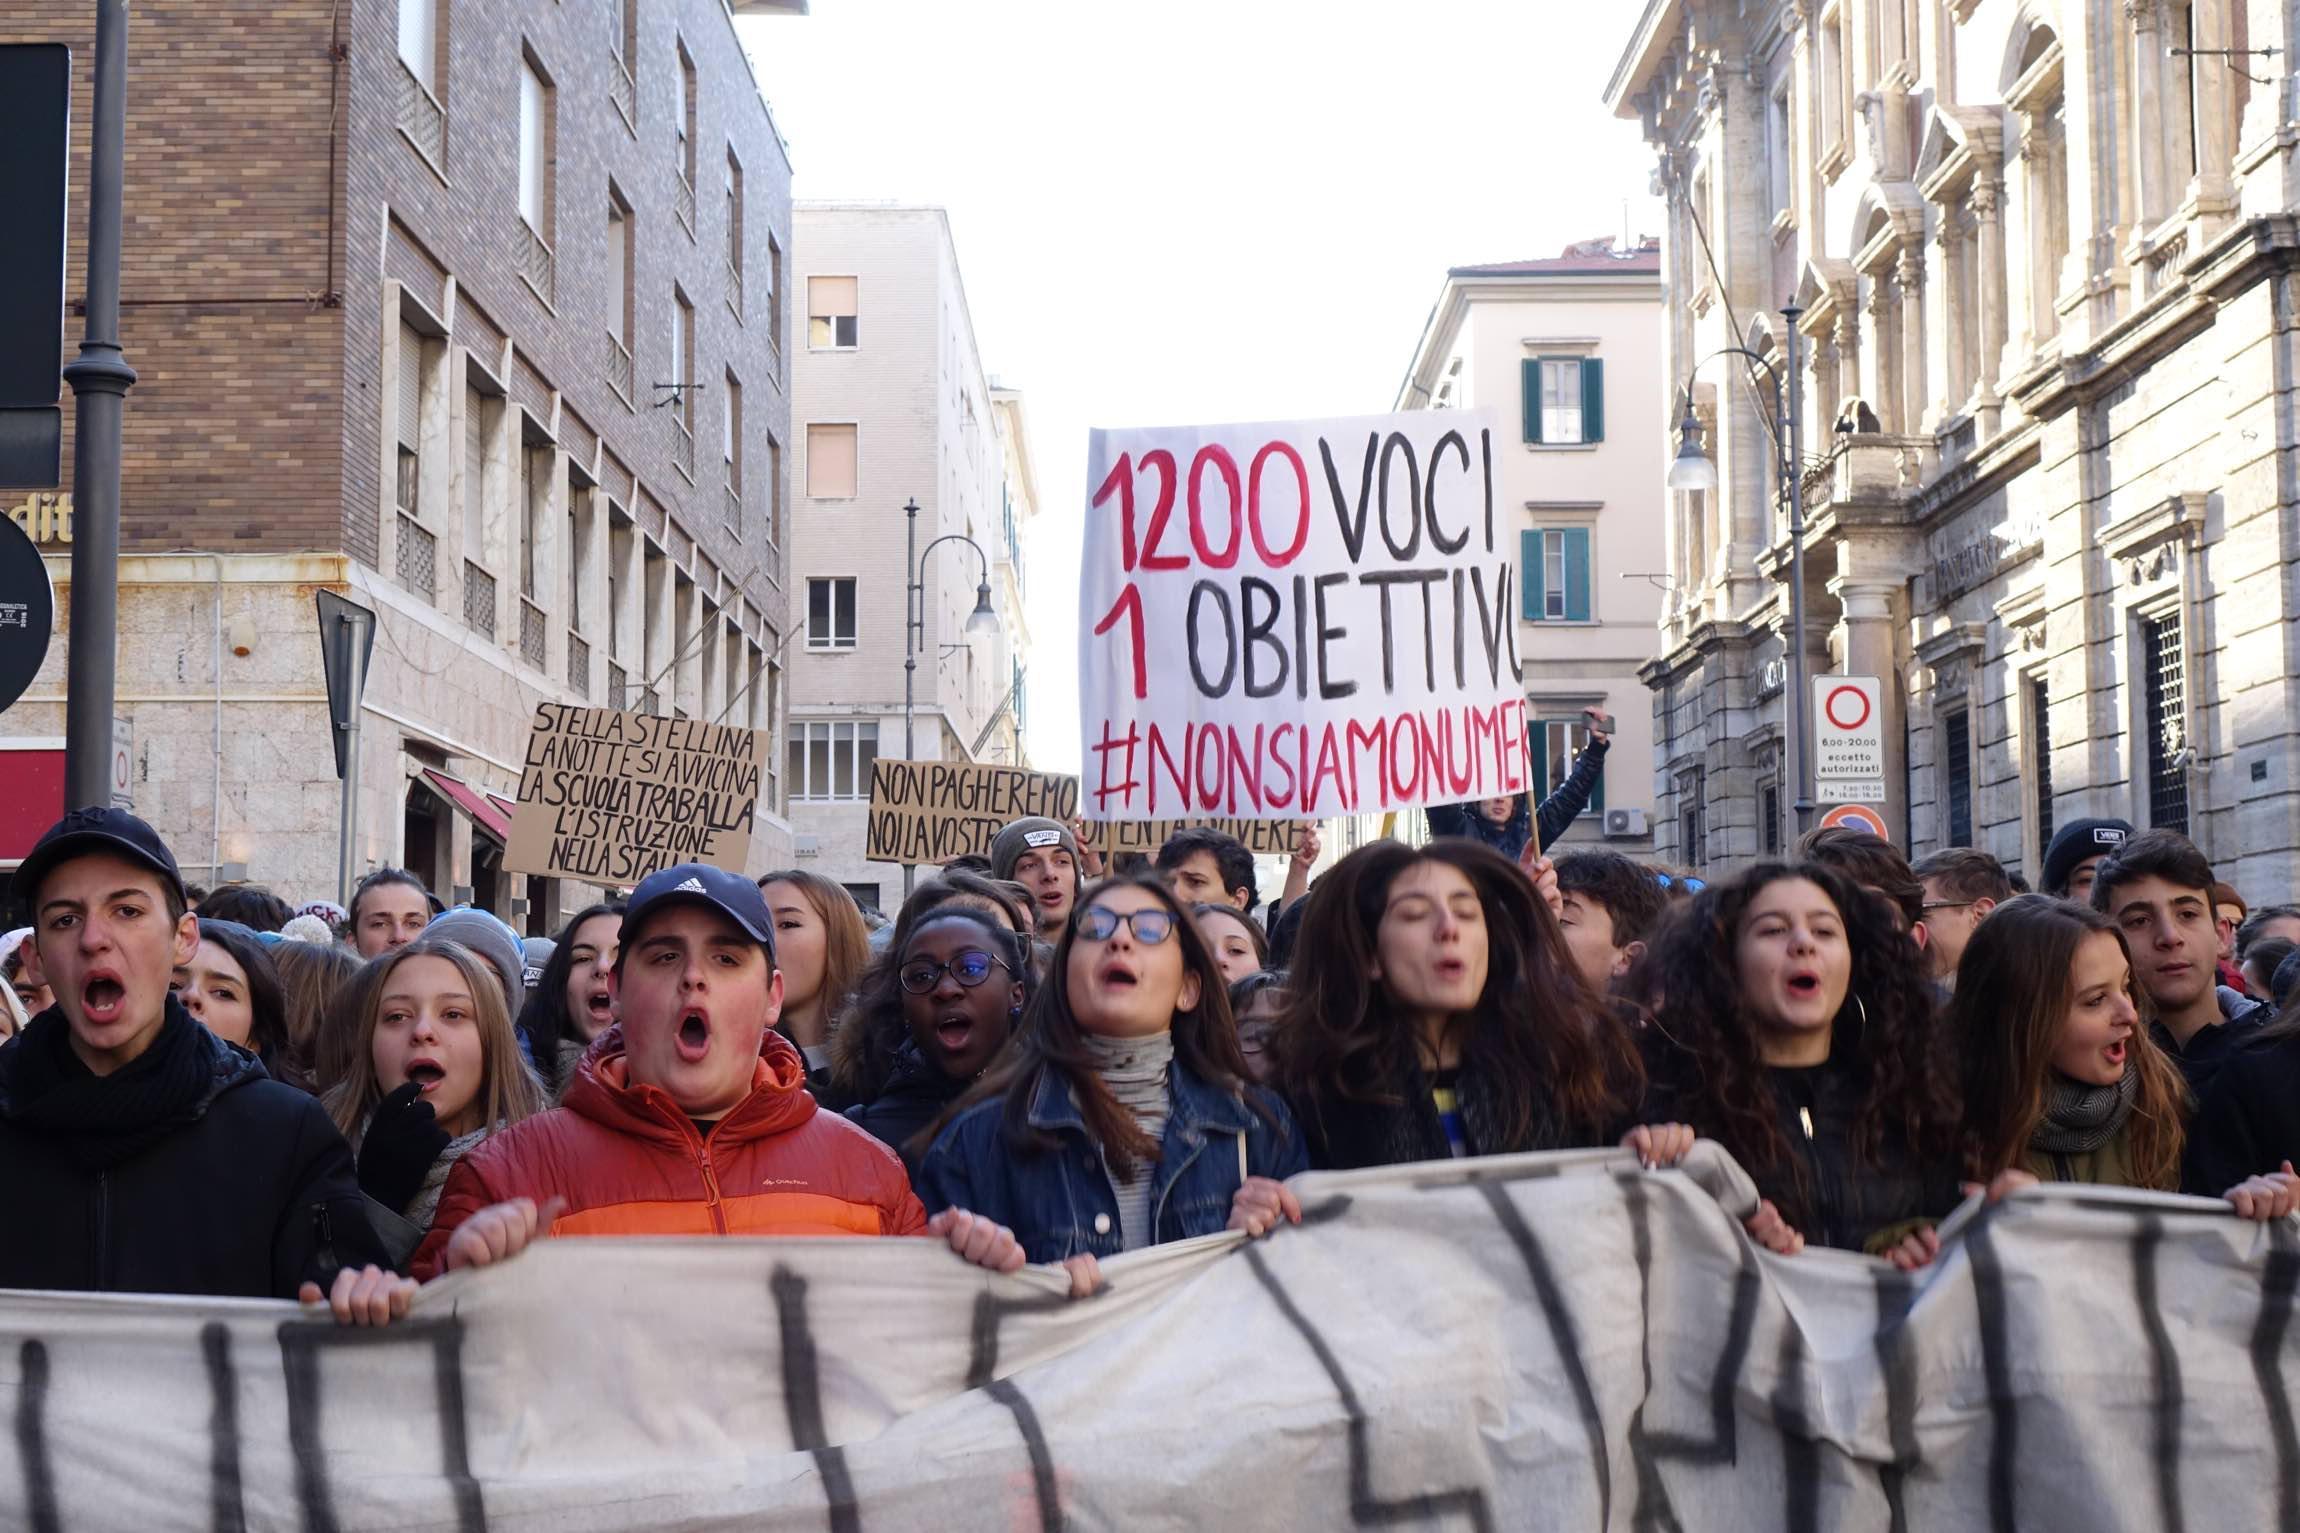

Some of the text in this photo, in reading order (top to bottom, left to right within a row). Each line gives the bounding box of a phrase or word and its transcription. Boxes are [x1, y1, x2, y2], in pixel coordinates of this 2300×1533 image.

[1092, 428, 1493, 571] 1200 VOCI
[1094, 583, 1147, 700] 1
[533, 703, 754, 760] STELLA STELLINA
[1828, 753, 1871, 761] eccetto
[526, 734, 759, 798] LA NOTTE SI AVVICINA
[870, 763, 1077, 820] NON PAGHEREMO
[1821, 764, 1879, 773] autorizzati
[517, 768, 754, 834] LA SCUOLA TRABALLA
[548, 838, 698, 881] NELLA STA
[555, 806, 721, 856] L'ISTRUZIONE
[867, 810, 1009, 859] NOI LA VOSTR
